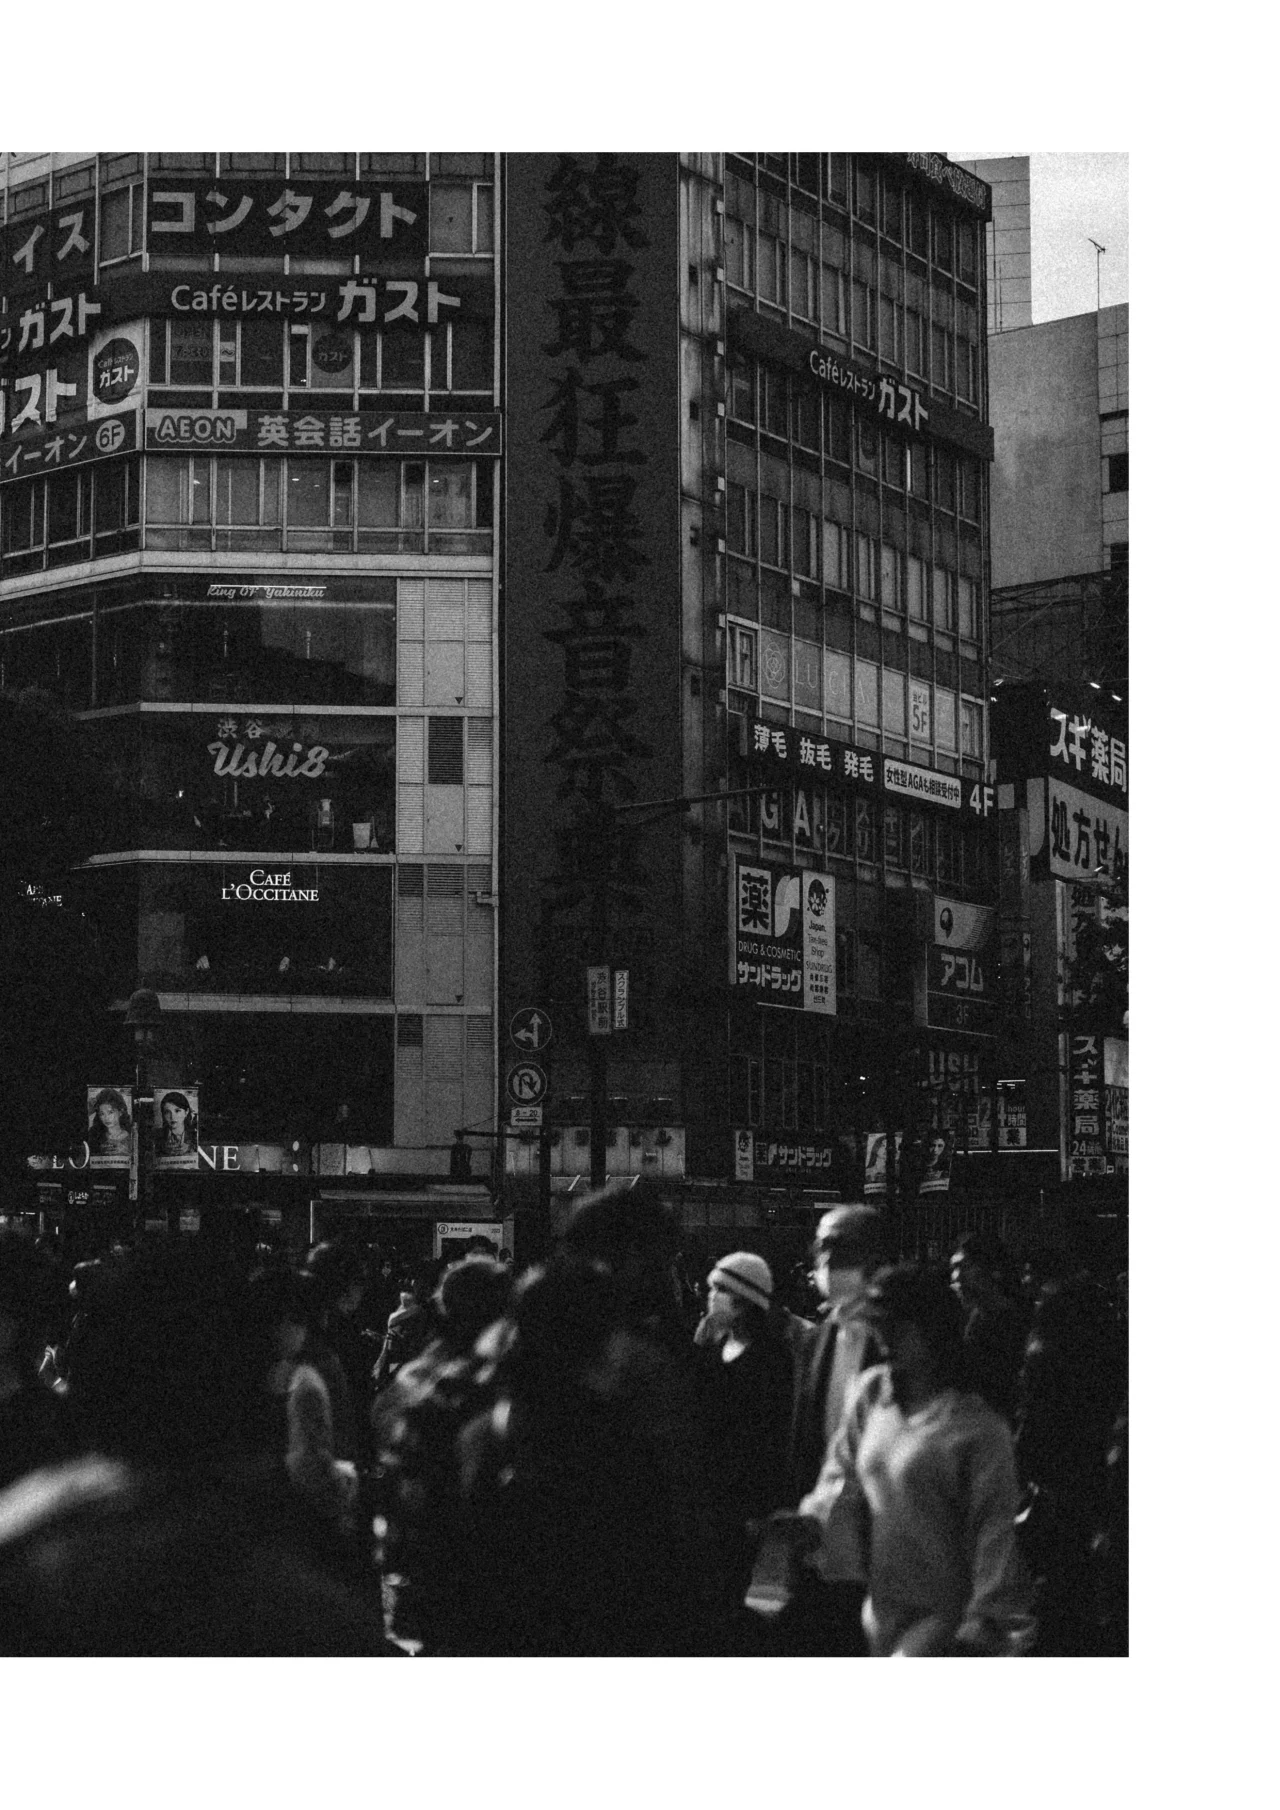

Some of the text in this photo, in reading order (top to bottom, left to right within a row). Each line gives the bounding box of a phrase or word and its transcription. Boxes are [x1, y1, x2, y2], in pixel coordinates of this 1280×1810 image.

[151, 189, 418, 239] コンタクト
[337, 277, 462, 323] ガスト
[19, 292, 102, 352] ガスト
[99, 365, 135, 389] ガスト
[878, 377, 929, 430] ガスト
[99, 425, 121, 448] 6F
[160, 415, 493, 447] AEON 英会話イーオン
[912, 704, 928, 733] 5F
[206, 741, 330, 779] Ushi8
[754, 723, 788, 759] 薄毛
[799, 737, 832, 771] 抜毛
[843, 750, 874, 783] 発毛
[969, 784, 994, 817] 4F
[1049, 707, 1129, 794] スギ薬局
[250, 870, 292, 887] CAFÉ
[740, 870, 772, 932] 薬
[738, 940, 760, 957] DRUG
[767, 945, 802, 962] COSMETIC
[737, 961, 802, 992] サンドラッグ
[940, 953, 985, 992] アコム
[1072, 1034, 1101, 1136] スギ薬局
